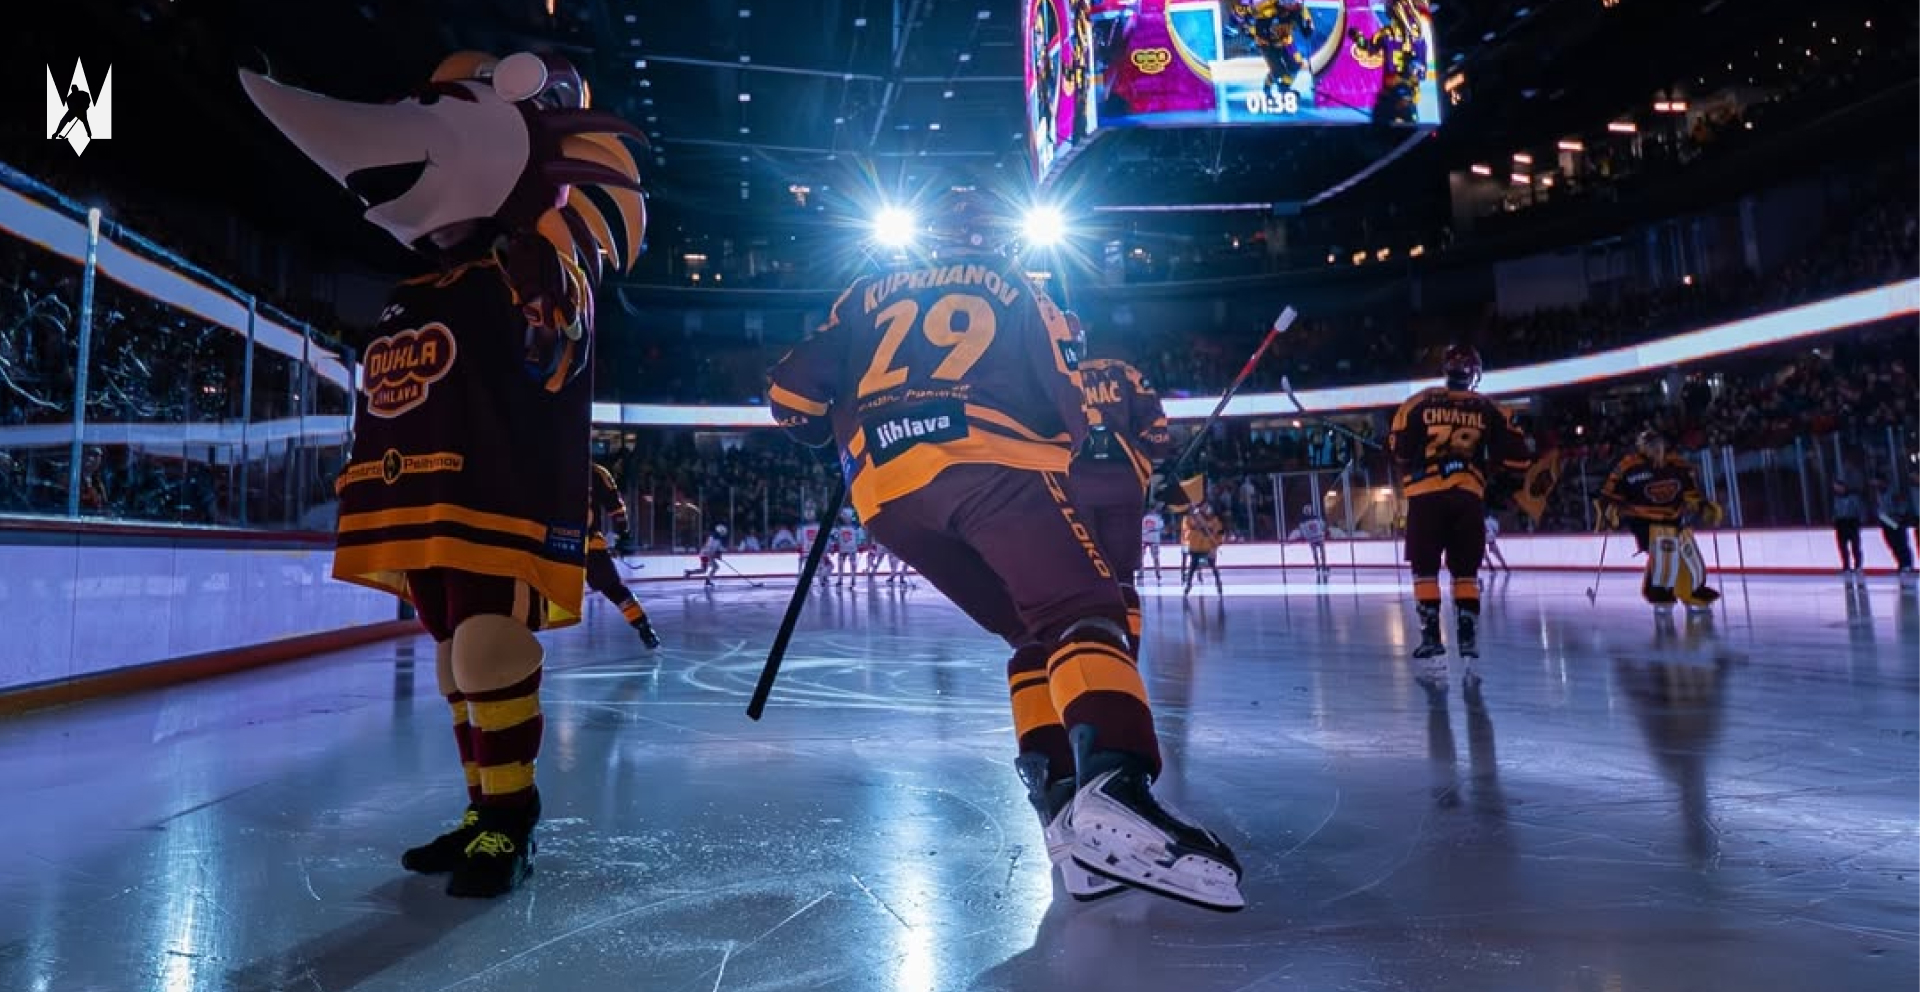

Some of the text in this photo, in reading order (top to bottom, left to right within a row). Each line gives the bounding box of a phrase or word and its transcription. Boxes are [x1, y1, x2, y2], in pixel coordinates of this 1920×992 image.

[1246, 92, 1297, 115] 01:38
[370, 340, 438, 378] DUKLA
[857, 294, 996, 398] 29
[876, 415, 951, 449] Jihlava
[1061, 507, 1111, 578] LOKO
